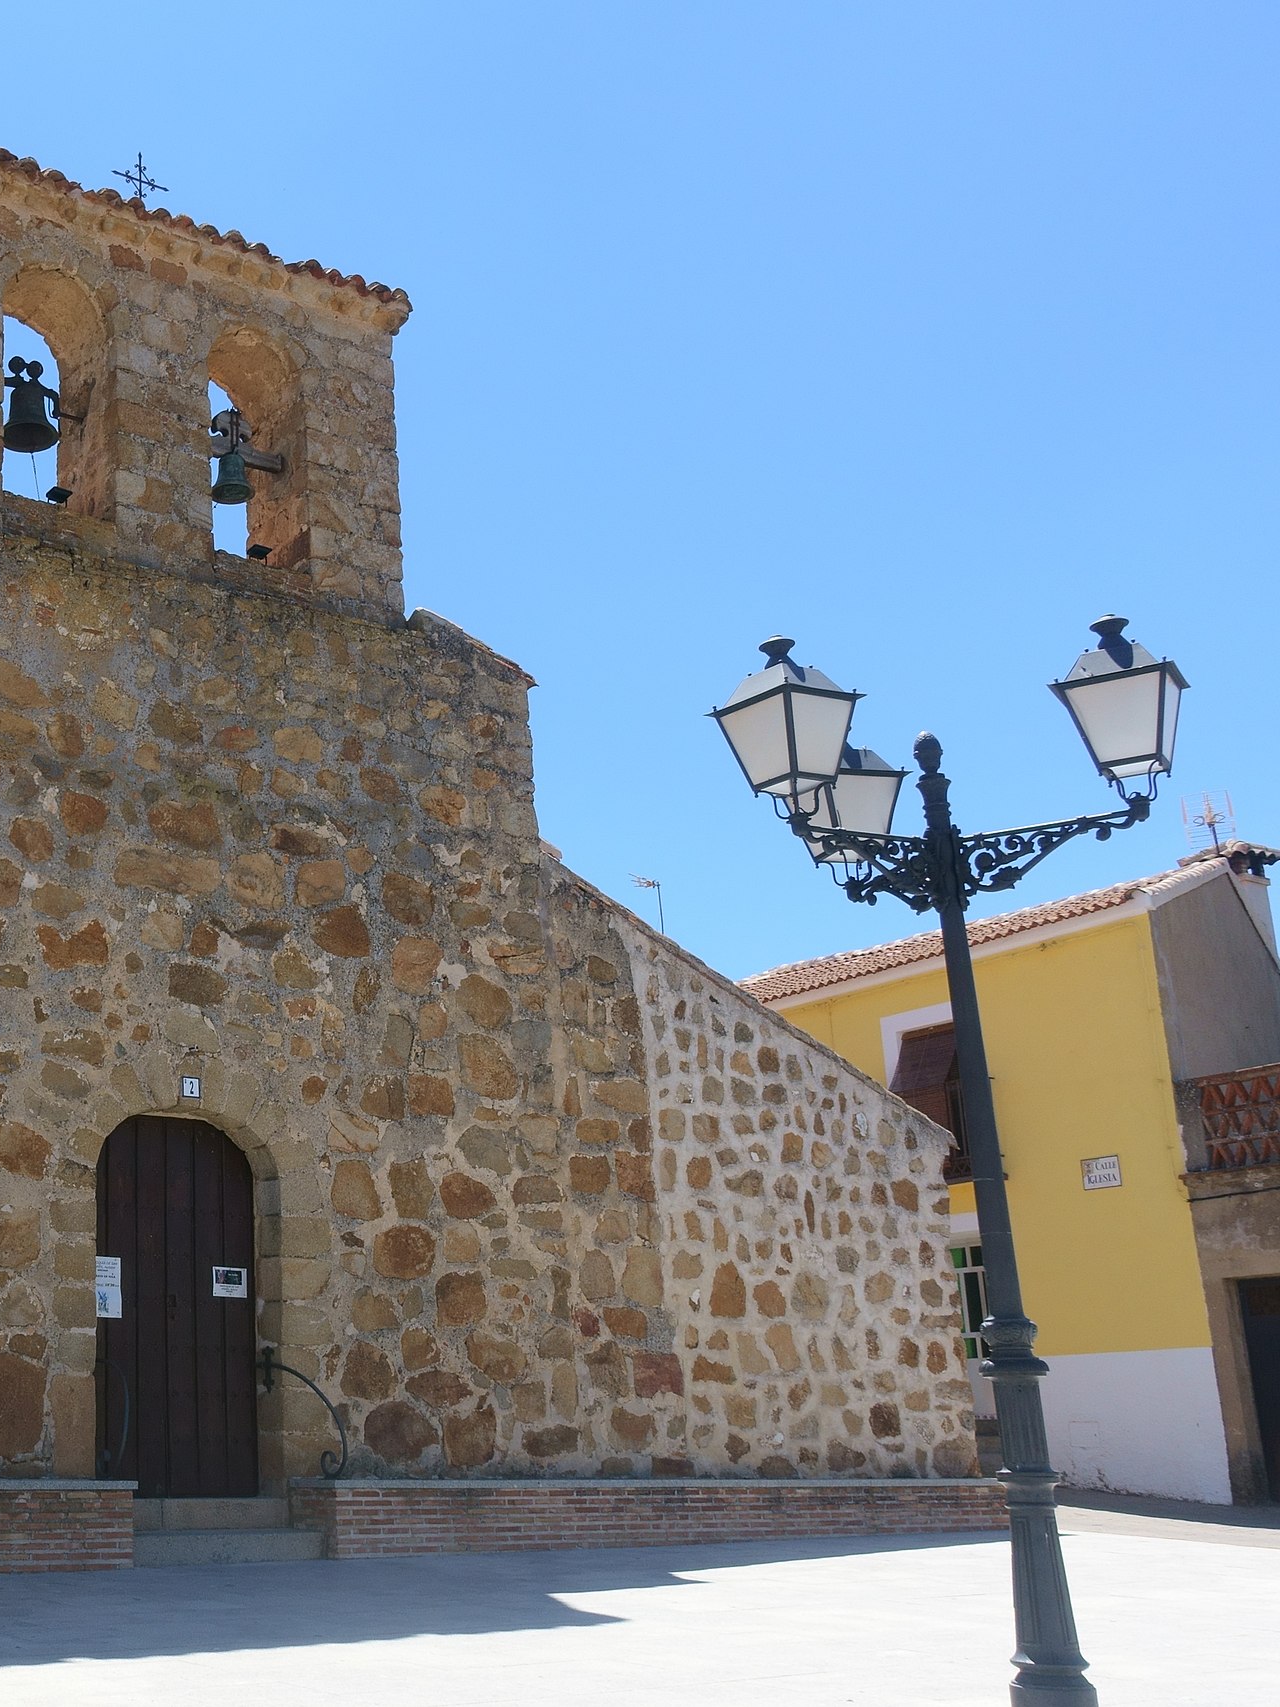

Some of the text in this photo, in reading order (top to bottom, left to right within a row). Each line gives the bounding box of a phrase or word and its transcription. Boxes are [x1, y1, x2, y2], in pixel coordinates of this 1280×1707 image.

[189, 1080, 195, 1095] 2
[1095, 1161, 1117, 1171] CALLE
[1087, 1173, 1118, 1185] IGLESIA
